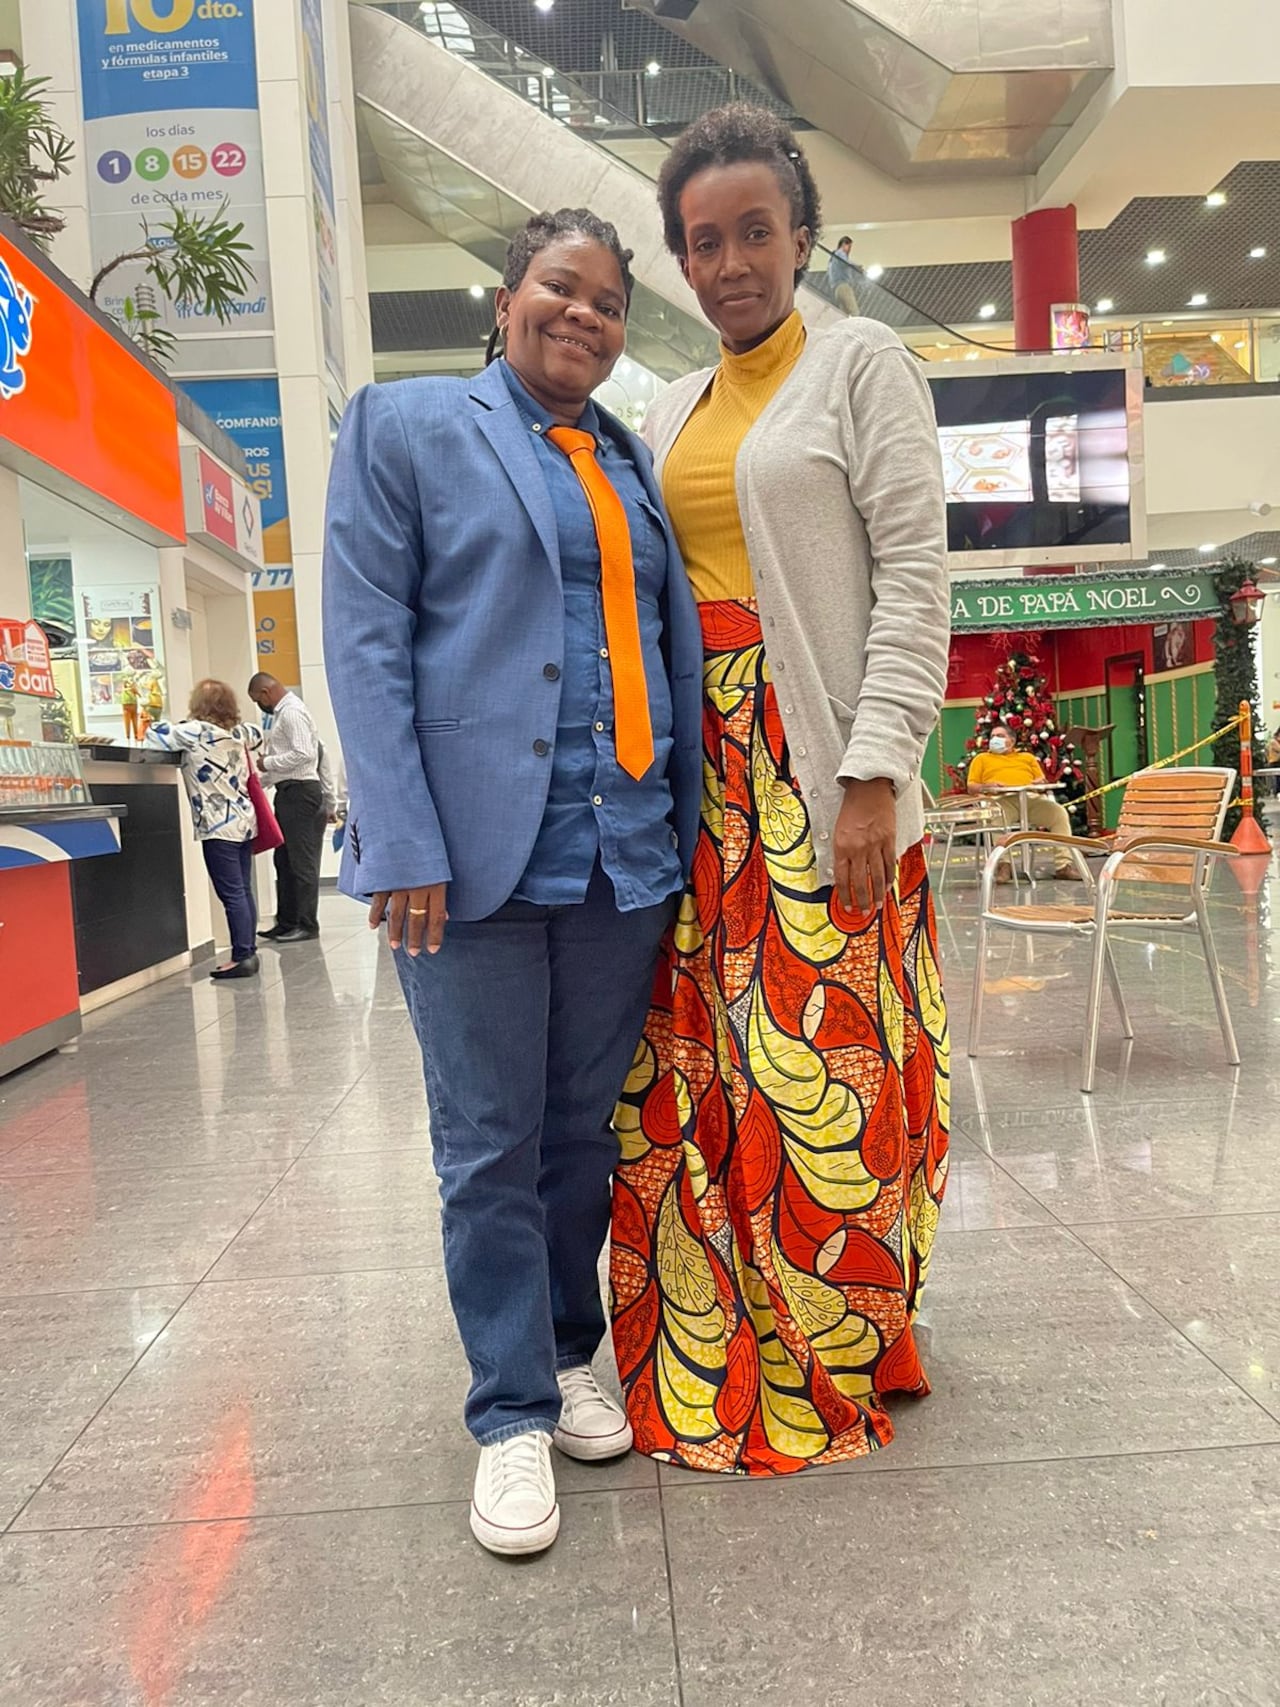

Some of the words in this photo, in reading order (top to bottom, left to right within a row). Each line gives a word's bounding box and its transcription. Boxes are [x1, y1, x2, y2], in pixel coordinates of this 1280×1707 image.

[197, 0, 244, 19] dto.
[109, 44, 124, 54] en
[126, 38, 220, 52] medicamentos
[102, 59, 109, 69] y
[111, 53, 168, 66] fórmulas
[170, 50, 229, 63] infantiles
[143, 68, 179, 80] etapa
[181, 67, 190, 77] 3
[146, 126, 166, 138] los
[168, 124, 196, 136] días
[109, 158, 121, 175] 1
[145, 155, 160, 172] 8
[177, 153, 202, 171] 15
[215, 150, 243, 168] 22
[131, 193, 150, 205] de
[153, 190, 188, 204] cada
[191, 189, 224, 202] mes
[977, 595, 1014, 617] DE
[1020, 588, 1080, 615] PAPÁ
[1086, 587, 1157, 611] NOEL
